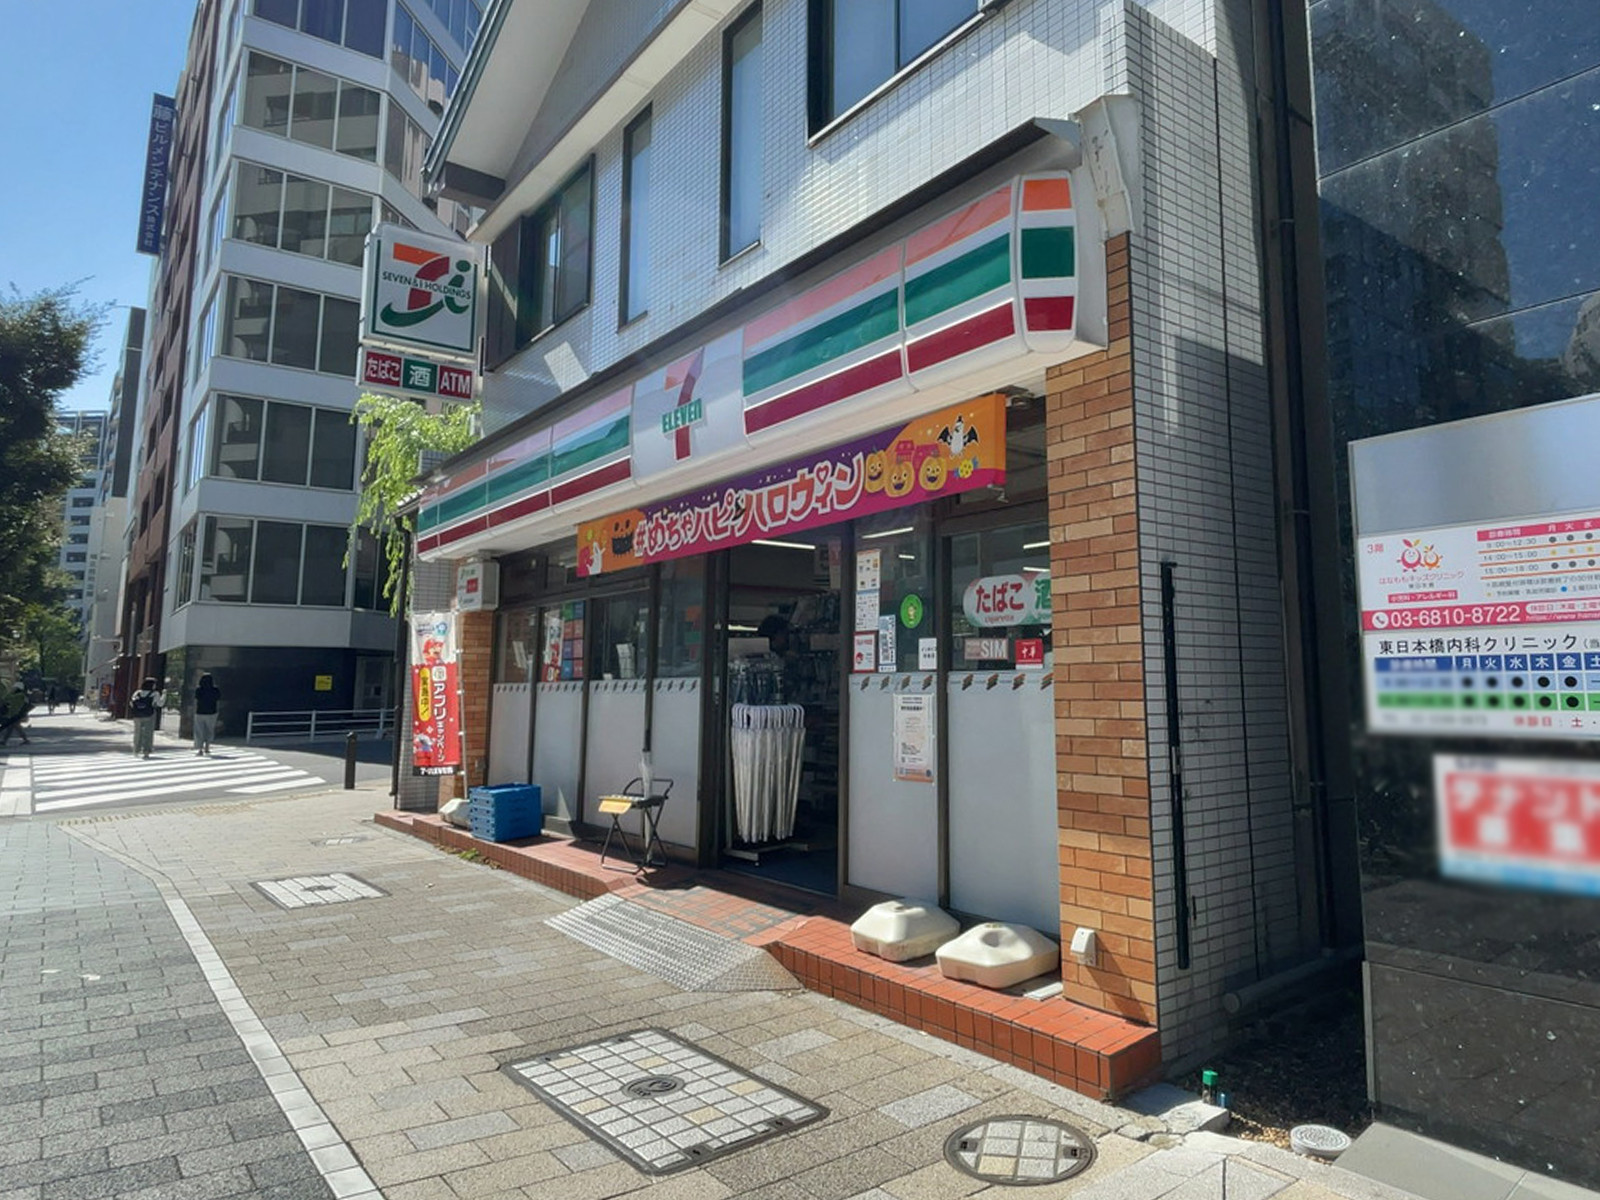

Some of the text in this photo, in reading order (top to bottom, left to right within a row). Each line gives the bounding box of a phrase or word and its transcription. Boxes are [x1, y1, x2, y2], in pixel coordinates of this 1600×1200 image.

[424, 282, 471, 299] HOLDINGS
[366, 357, 471, 394] たばこ 酒 ATM
[976, 582, 1024, 613] たばこ
[1390, 605, 1520, 628] 03-6810-8722
[981, 640, 1006, 658] SIM
[1379, 634, 1577, 654] 東日本橋内科クリニック
[1463, 657, 1472, 668] 月
[1485, 657, 1497, 669] 火
[1509, 656, 1523, 669] 水
[1535, 655, 1550, 668] 木
[1562, 655, 1577, 668] 金
